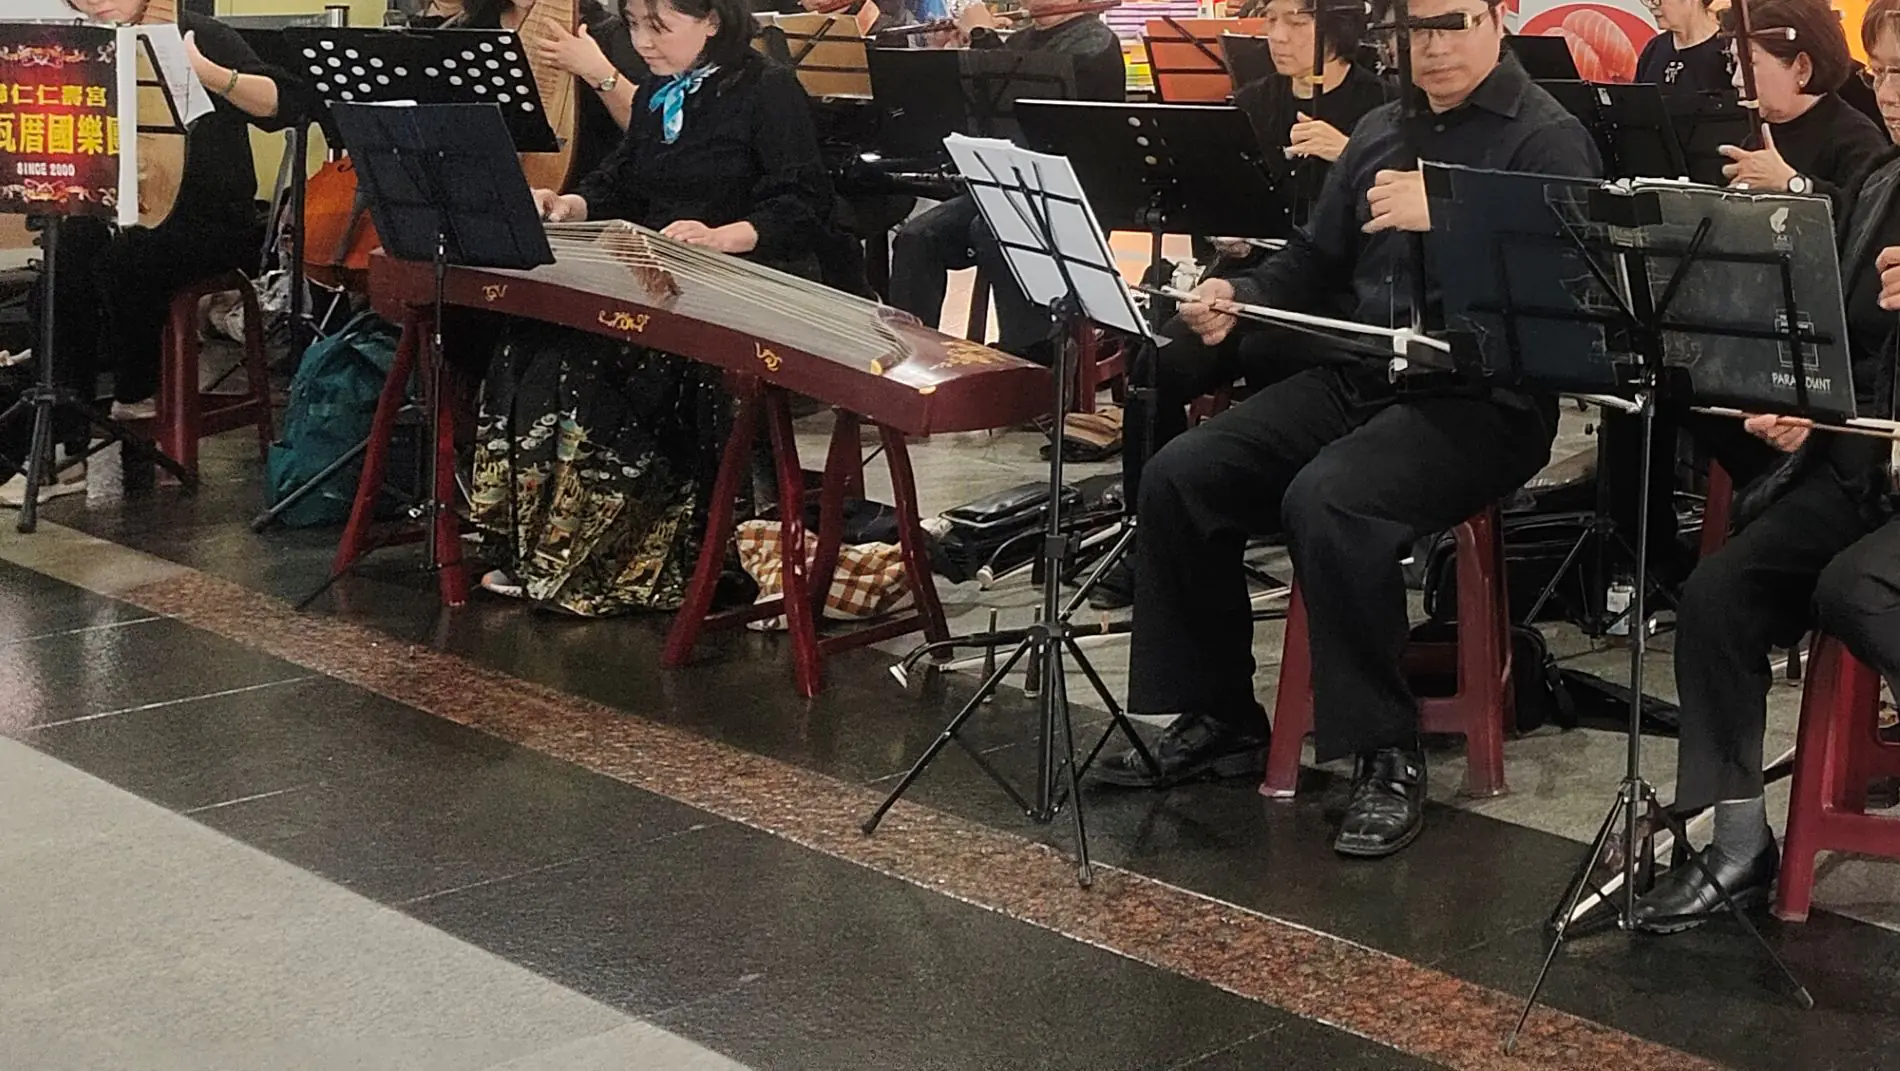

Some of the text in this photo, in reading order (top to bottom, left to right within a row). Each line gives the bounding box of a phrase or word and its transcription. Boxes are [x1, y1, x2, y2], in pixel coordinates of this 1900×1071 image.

[16, 161, 76, 177] SINCE 2000
[1771, 371, 1832, 393] PARAOUNT
